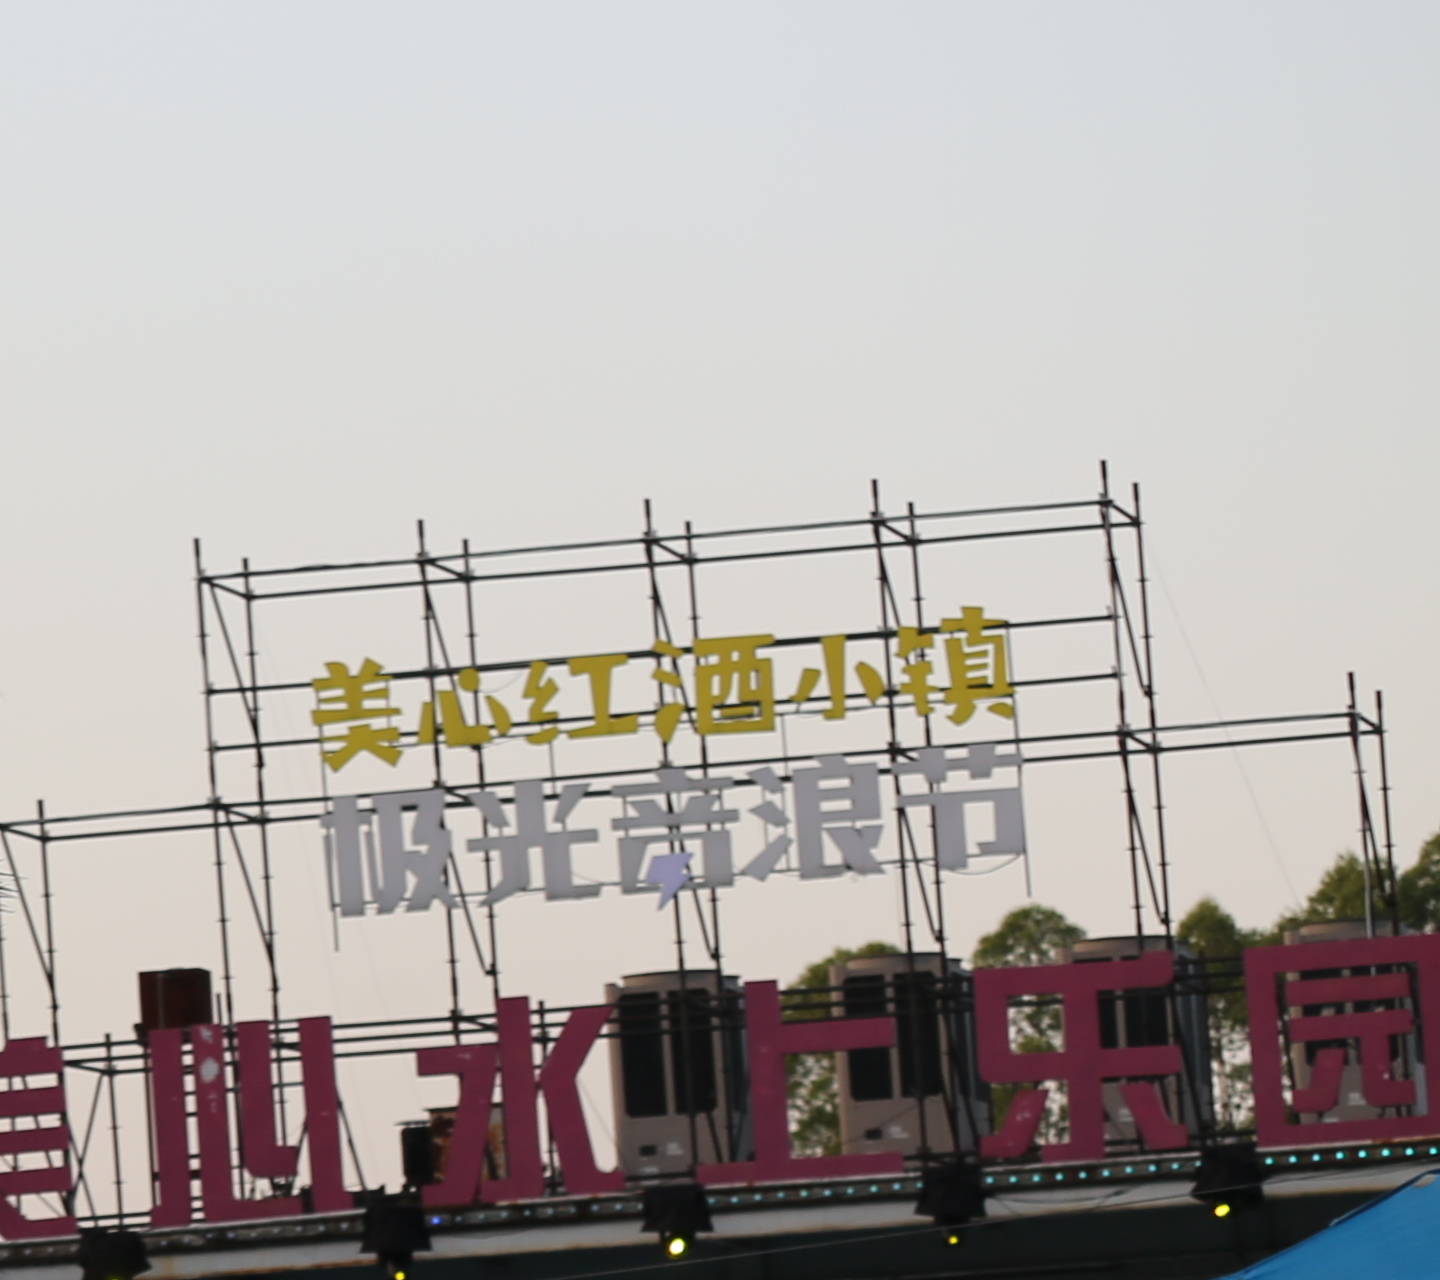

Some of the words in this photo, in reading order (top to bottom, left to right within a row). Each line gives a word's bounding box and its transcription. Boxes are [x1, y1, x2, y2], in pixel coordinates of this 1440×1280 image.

[311, 606, 1015, 772] 美心红酒小镇
[320, 745, 1026, 917] 极光音浪节
